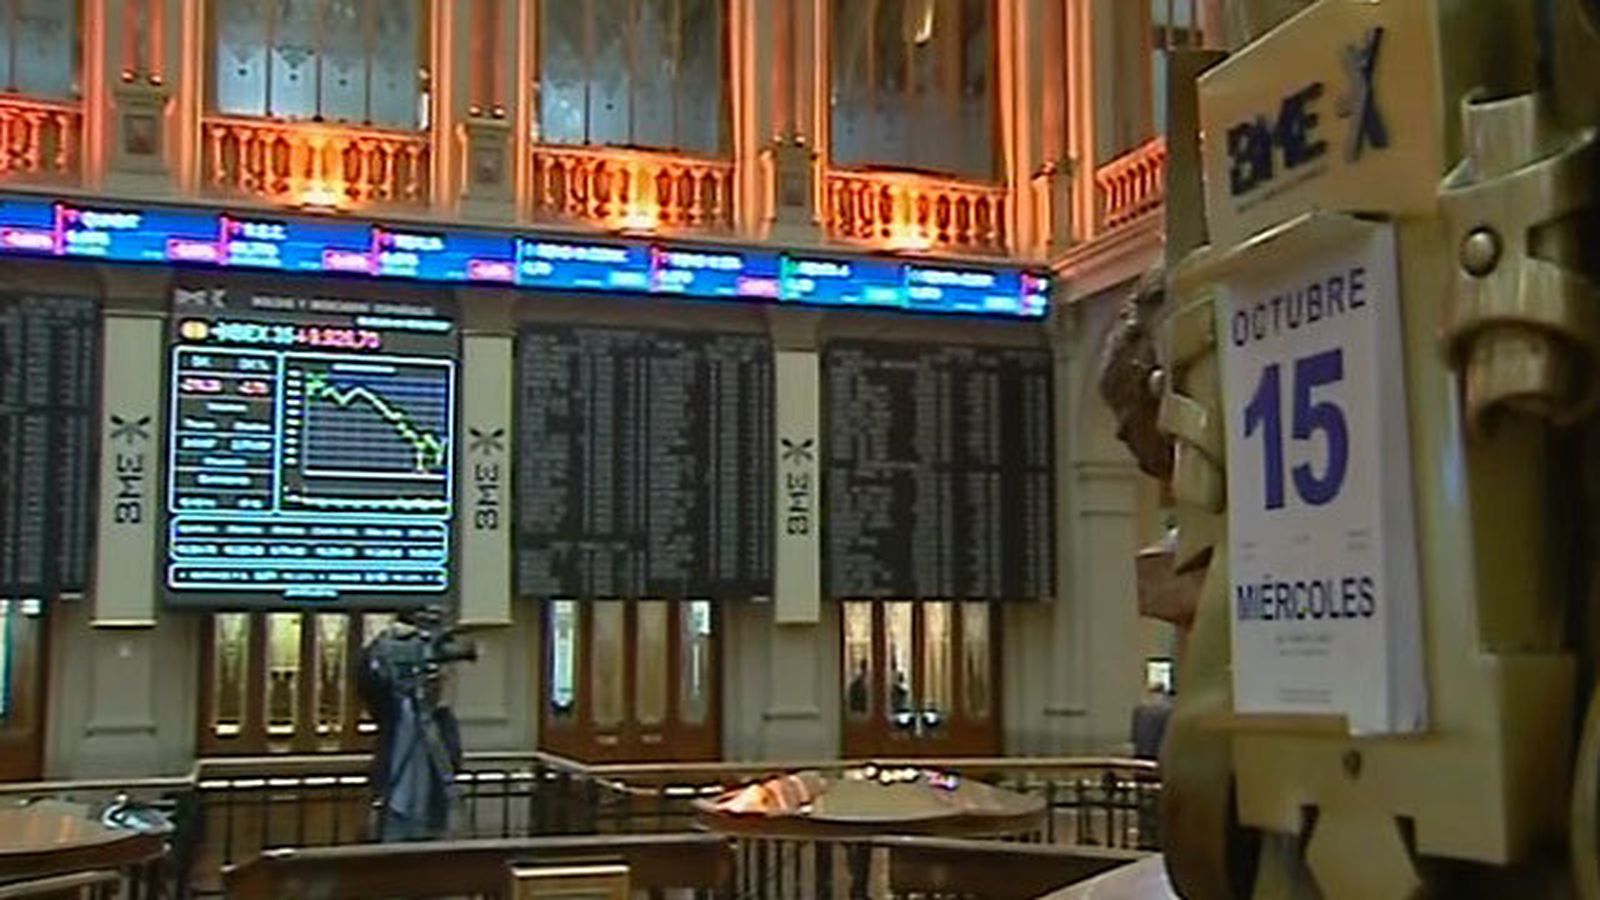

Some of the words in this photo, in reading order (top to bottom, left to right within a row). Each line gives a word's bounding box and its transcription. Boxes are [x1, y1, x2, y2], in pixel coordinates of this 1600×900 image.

[1227, 82, 1328, 196] BME
[1231, 267, 1366, 347] OCTUBRE
[1244, 347, 1349, 511] 15
[115, 454, 143, 524] BME
[475, 464, 499, 530] BME
[786, 472, 809, 535] BME
[1236, 573, 1376, 621] MIÉRCOLES
